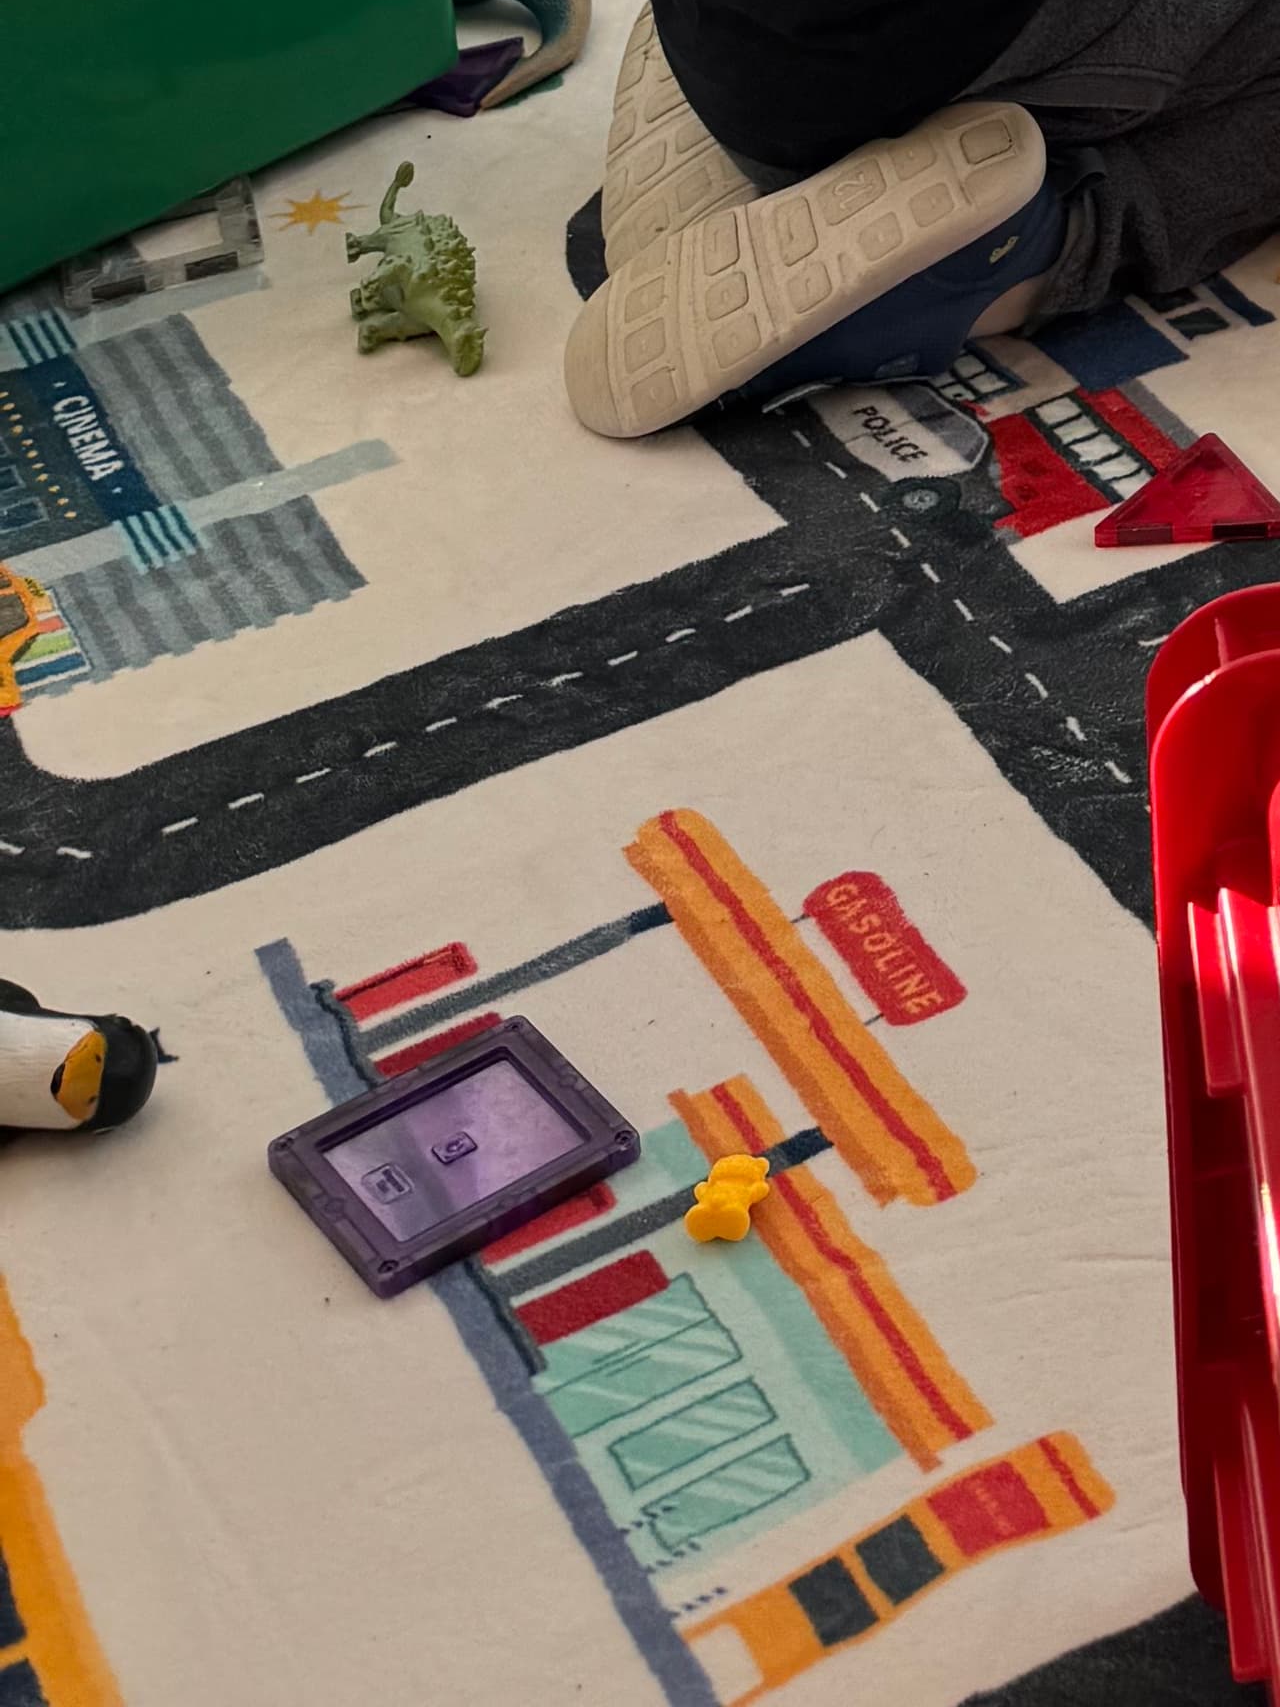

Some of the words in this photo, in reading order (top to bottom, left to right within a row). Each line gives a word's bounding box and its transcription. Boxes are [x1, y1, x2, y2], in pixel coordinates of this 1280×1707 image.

[53, 395, 124, 481] CINEMA
[852, 405, 929, 463] POLICE
[826, 883, 944, 1014] GASOLINE
